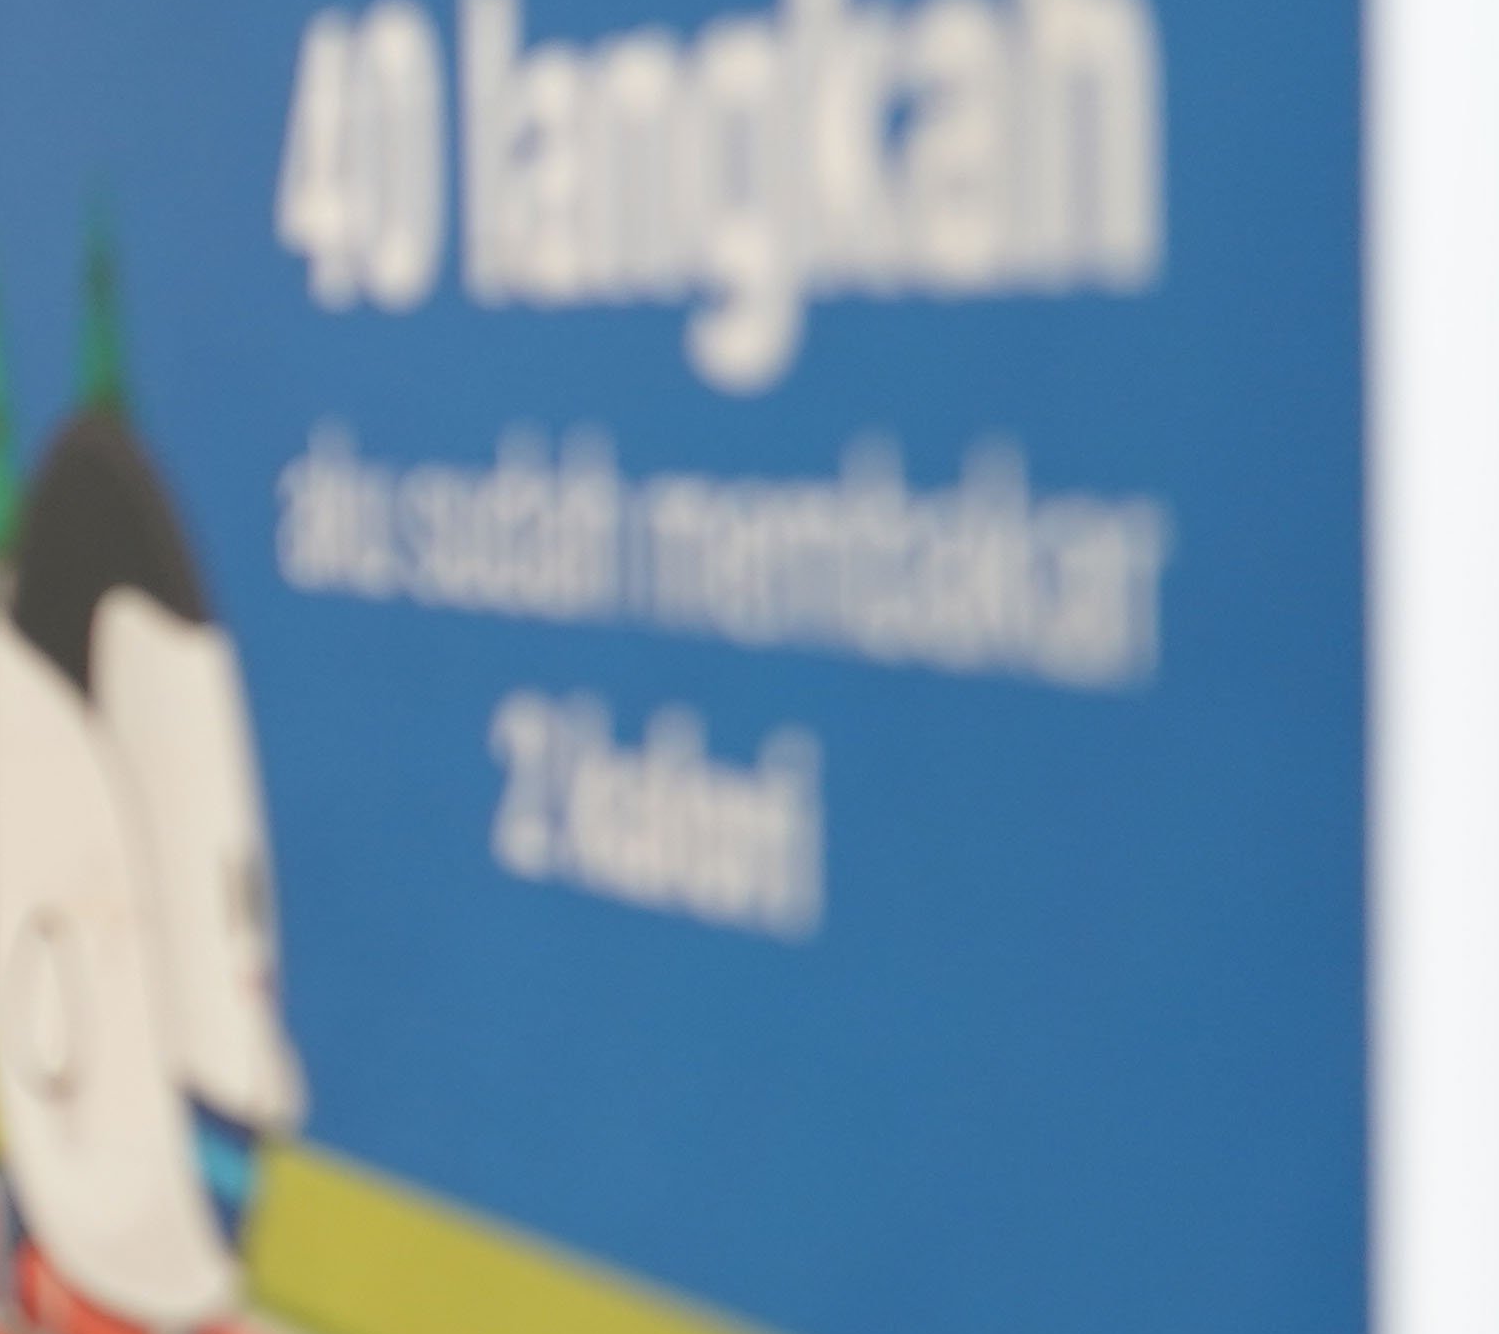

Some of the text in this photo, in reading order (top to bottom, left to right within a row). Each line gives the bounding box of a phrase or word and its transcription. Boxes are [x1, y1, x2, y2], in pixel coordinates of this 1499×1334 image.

[278, 420, 1170, 689] aku sudah membakar
[489, 689, 825, 942] 2 kalori
